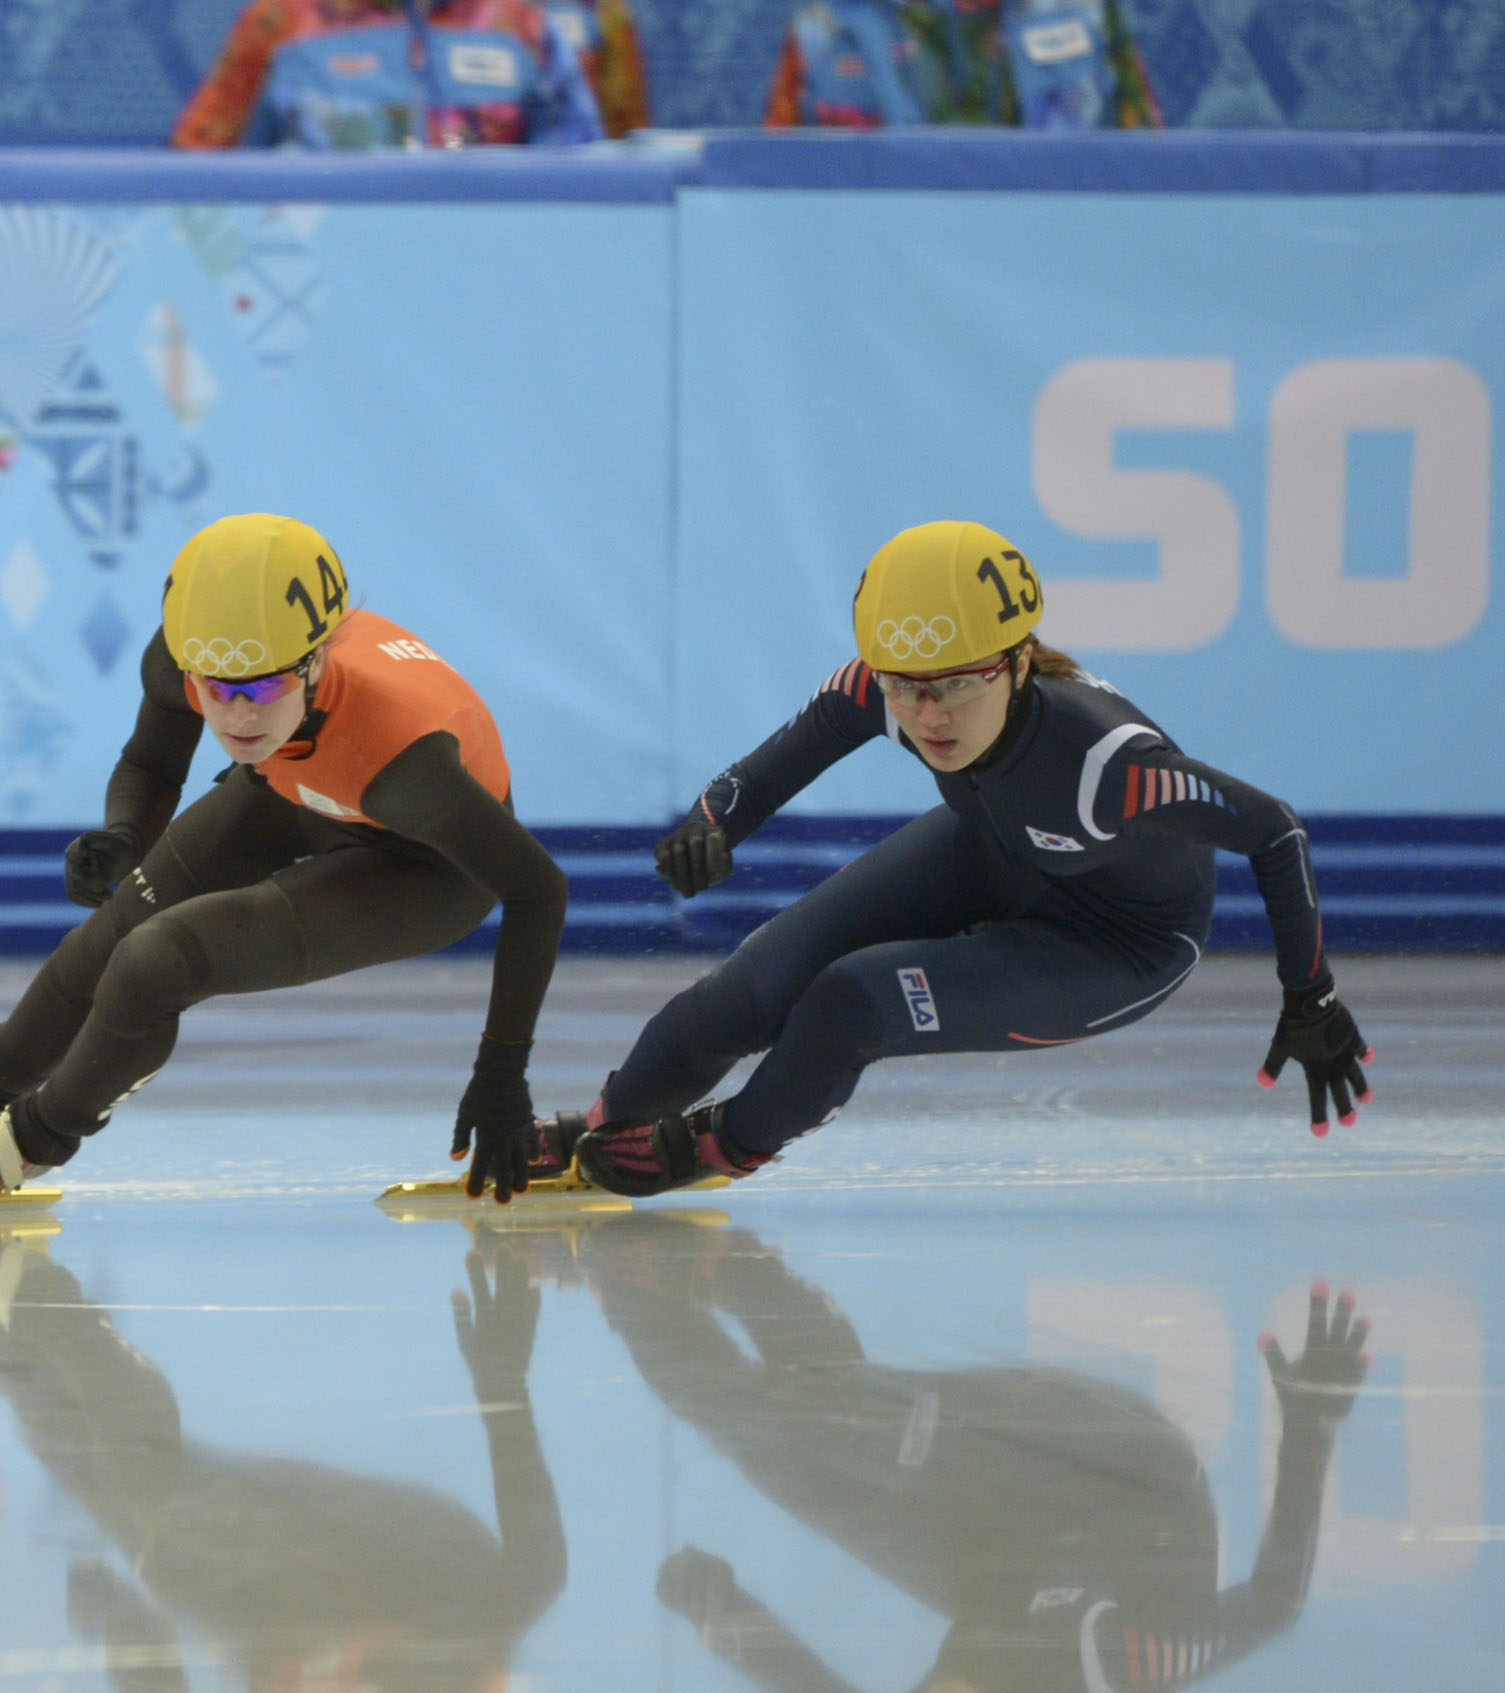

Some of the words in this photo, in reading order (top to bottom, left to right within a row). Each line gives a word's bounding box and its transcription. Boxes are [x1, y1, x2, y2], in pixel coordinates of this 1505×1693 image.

[1031, 355, 1492, 652] SO
[285, 554, 347, 644] 14
[977, 550, 1043, 624] 13
[902, 973, 934, 1027] FILA
